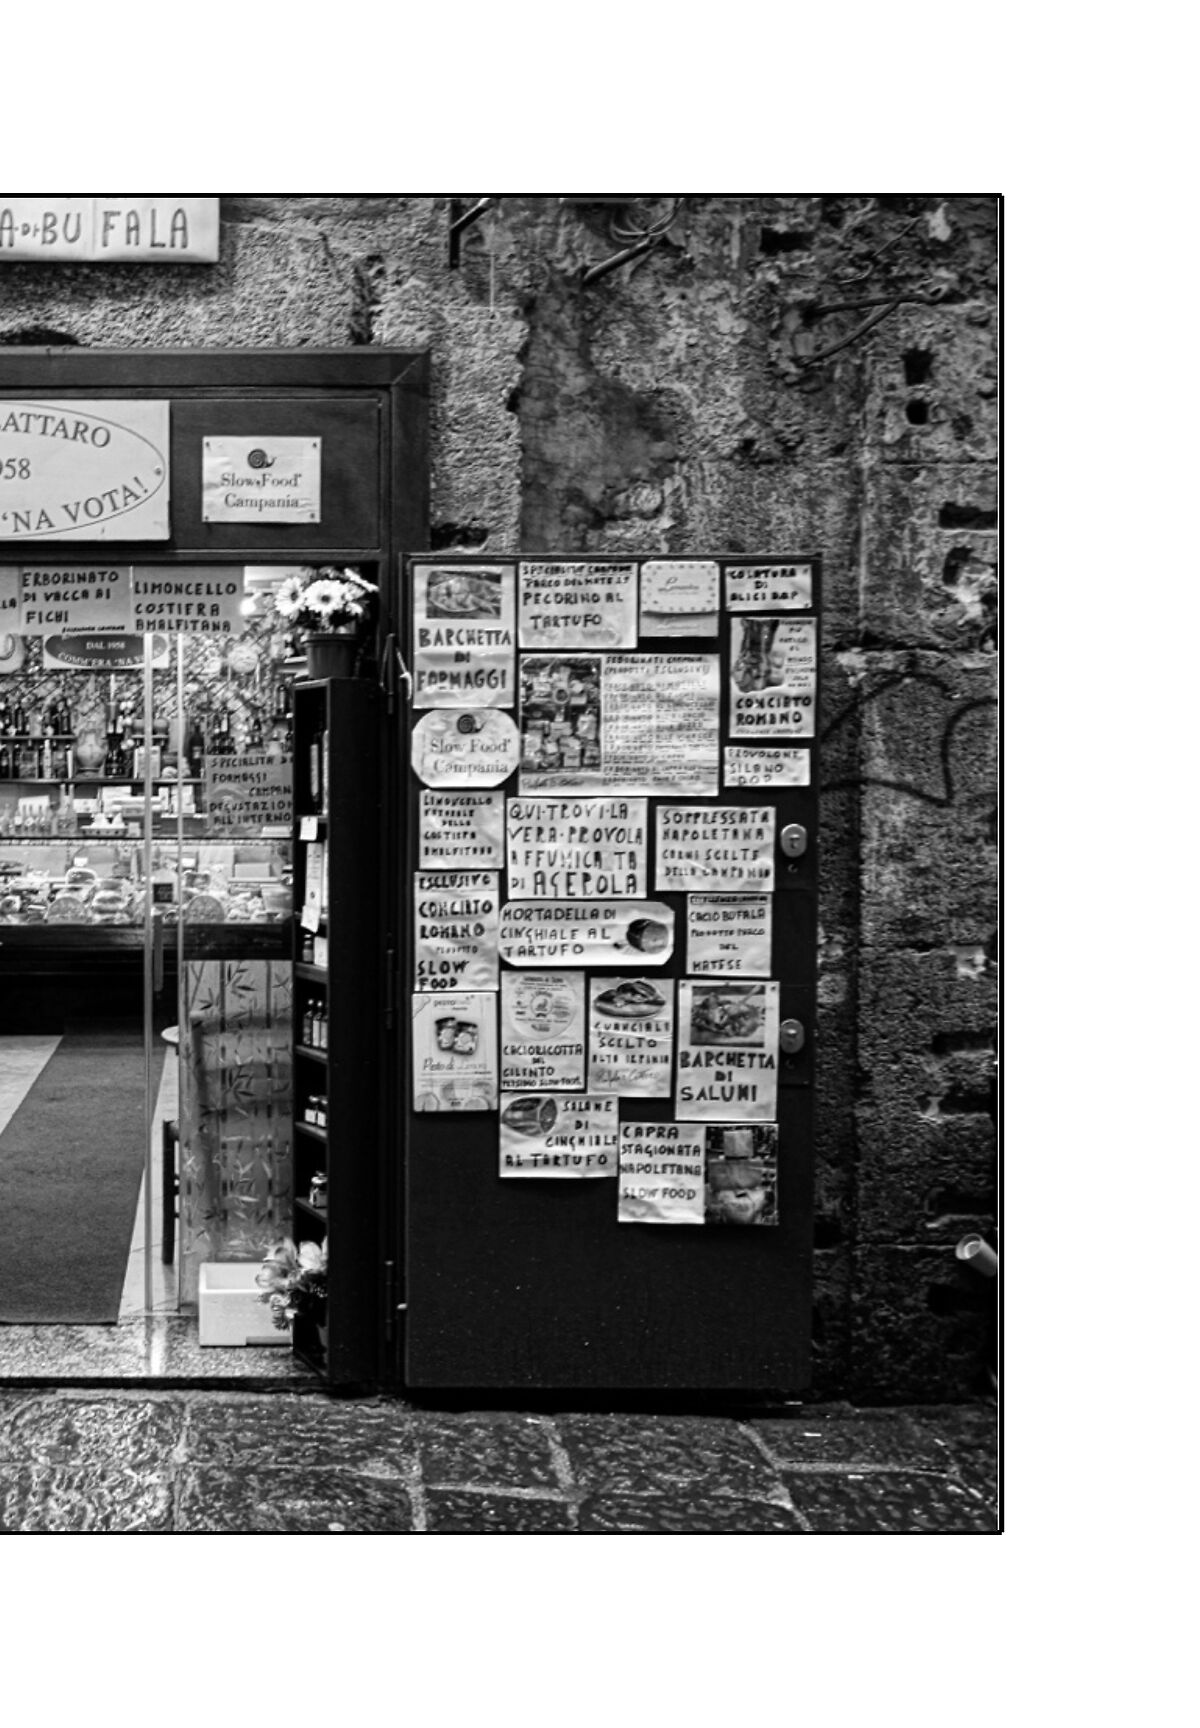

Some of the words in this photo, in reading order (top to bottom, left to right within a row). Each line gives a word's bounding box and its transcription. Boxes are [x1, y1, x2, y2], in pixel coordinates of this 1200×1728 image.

[220, 472, 255, 488] Slow
[261, 473, 300, 488] Food
[62, 475, 151, 523] VOTA!
[224, 492, 300, 512] Campania
[22, 571, 120, 588] ERBORINATO
[22, 591, 37, 603] DI
[44, 588, 90, 603] VACCA
[134, 581, 238, 596] LIMONCELLO
[522, 592, 601, 606] PECORINO
[605, 592, 624, 603] AL
[134, 602, 221, 616] COSTIERA
[26, 610, 69, 625] FICHI
[529, 614, 602, 630] TARTUFO
[134, 618, 232, 633] AMALFITANA
[418, 627, 513, 648] BARCHETTA
[454, 650, 471, 663] DI
[417, 668, 507, 691] FORMAGGI
[735, 710, 803, 727] ROMANO
[430, 738, 465, 753] Slow
[433, 759, 509, 778] Campania
[662, 809, 770, 825] SOPPRESSATA
[662, 828, 765, 841] NAPOLETANA
[511, 877, 526, 890] DI
[533, 870, 638, 898] AGEROLA
[502, 907, 600, 922] MORTADELLA
[603, 908, 617, 921] DI
[500, 926, 579, 944] CINGHIALE
[587, 927, 612, 941] AL
[503, 943, 585, 958] TARTUFO
[417, 959, 470, 976] SLOW
[692, 959, 743, 972] MATESE
[418, 977, 459, 991] FOOD
[599, 1036, 658, 1049] SCELTO
[680, 1050, 776, 1070] BARCHETTA
[502, 1065, 555, 1078] CILENTO
[714, 1070, 734, 1082] DI
[681, 1084, 758, 1103] SALUMI
[562, 1101, 613, 1113] SALAME
[574, 1120, 590, 1131] DI
[622, 1126, 680, 1140] CAPRA
[621, 1144, 701, 1158] STAGIONATA
[505, 1154, 524, 1167] AL
[530, 1153, 609, 1167] TARTUFO
[661, 1187, 697, 1200] FOOD
